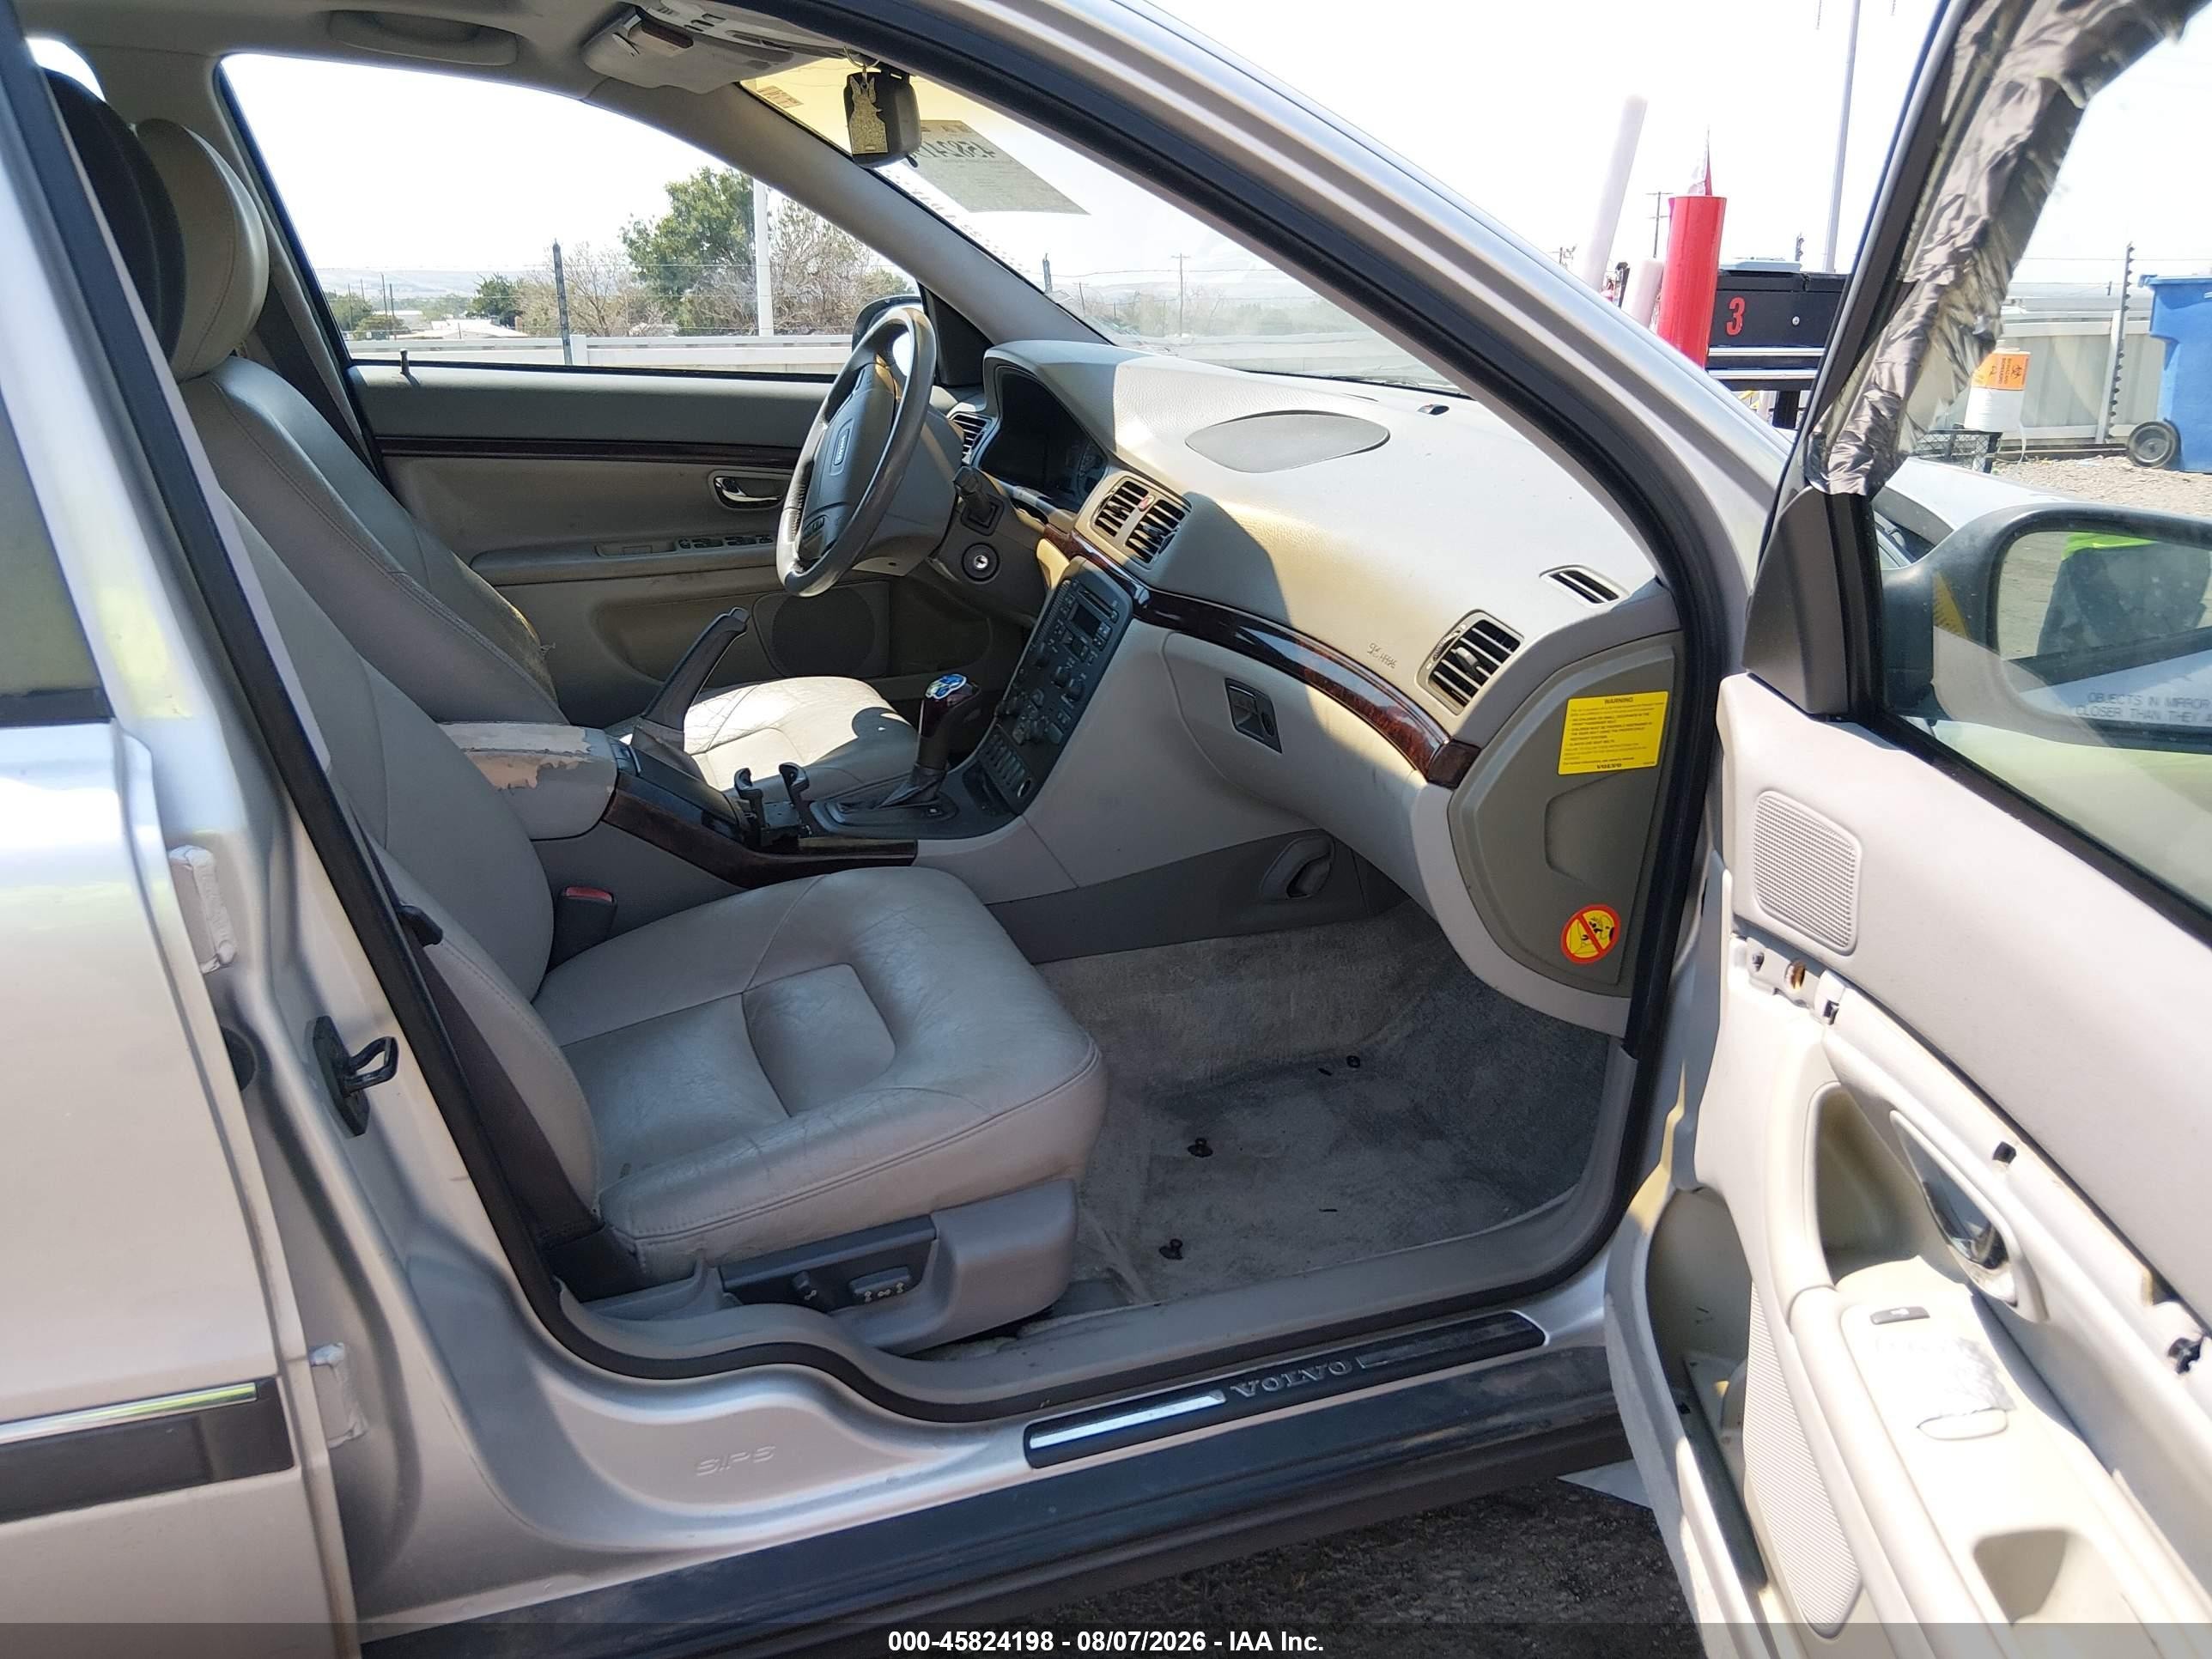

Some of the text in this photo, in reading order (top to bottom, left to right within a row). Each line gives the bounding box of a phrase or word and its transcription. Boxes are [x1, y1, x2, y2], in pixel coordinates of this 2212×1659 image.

[1726, 296, 1746, 336] 3
[2075, 705, 2123, 718] CLOSER
[2129, 708, 2162, 720] THAN
[2167, 710, 2198, 723] THEY
[2087, 692, 2210, 709] OBJECTS IN MIRROR
[1231, 1360, 1353, 1398] VOLVO
